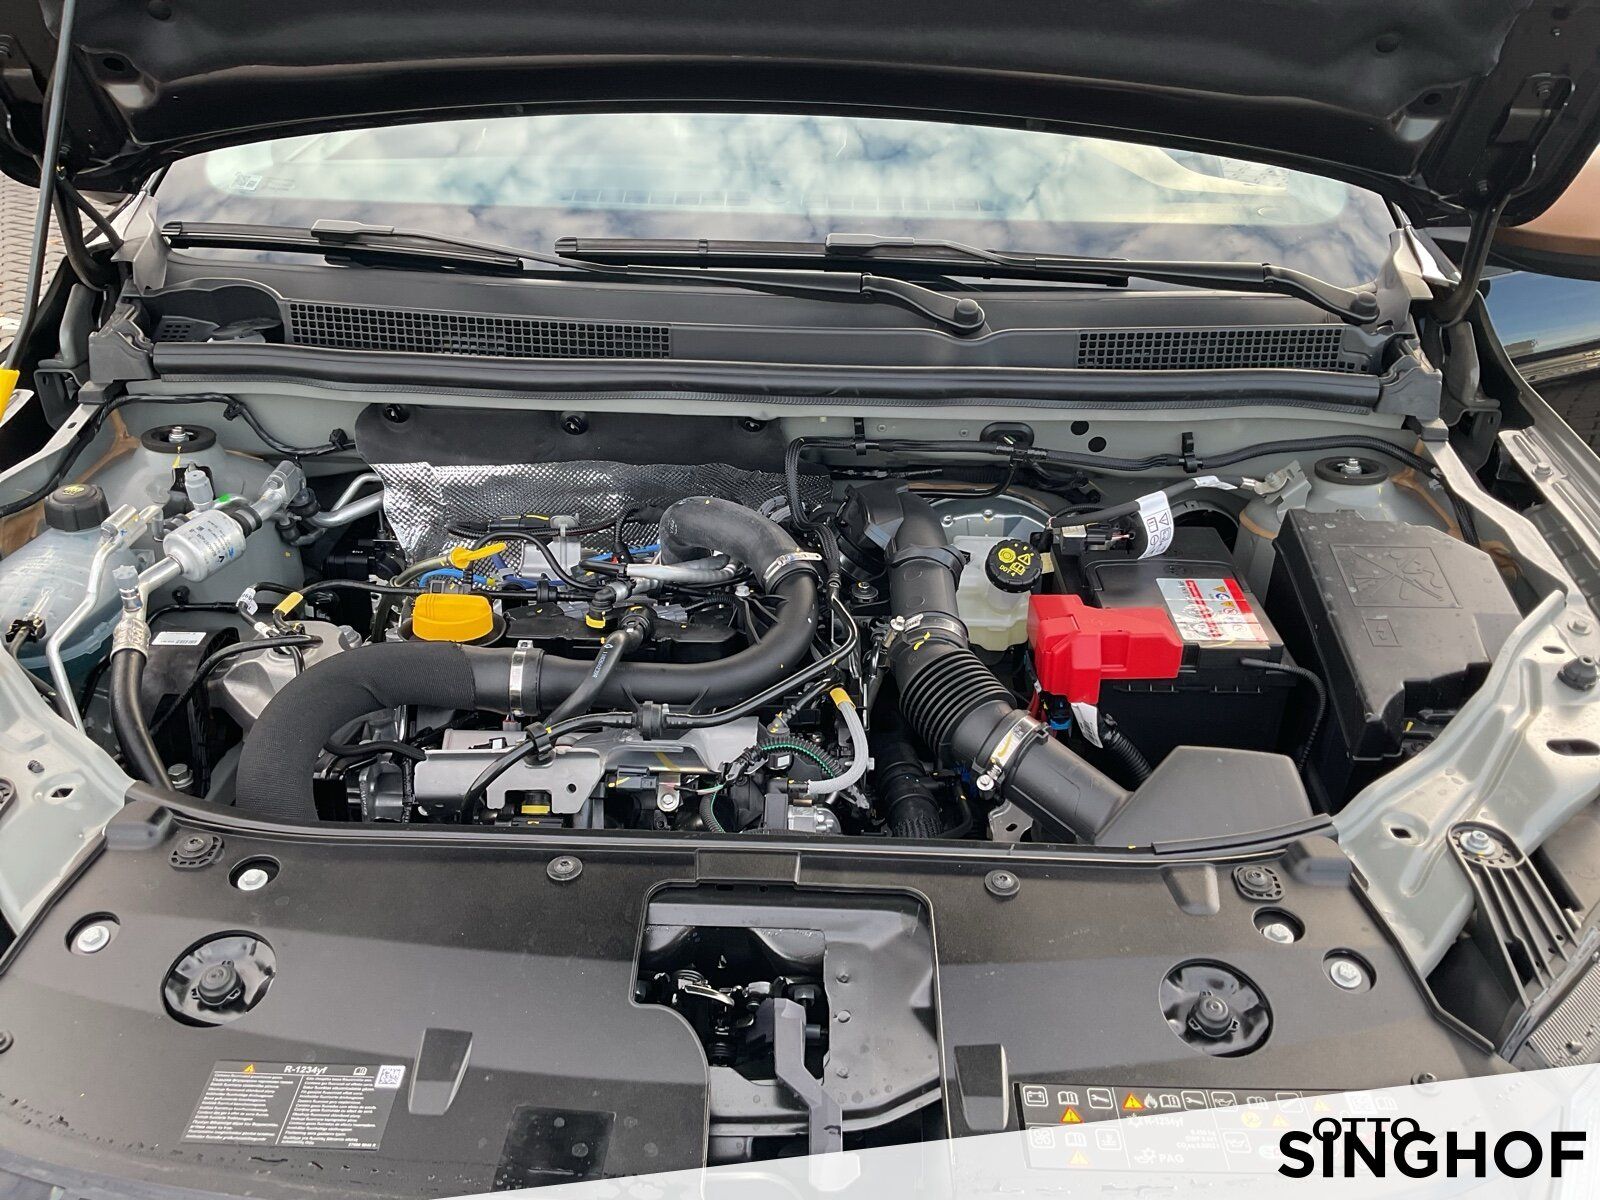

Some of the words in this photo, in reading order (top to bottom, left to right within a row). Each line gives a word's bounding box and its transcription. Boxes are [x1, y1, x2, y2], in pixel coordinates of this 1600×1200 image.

[999, 564, 1011, 574] DOT
[283, 1065, 328, 1077] R-1234yf
[1158, 1153, 1185, 1164] PAG
